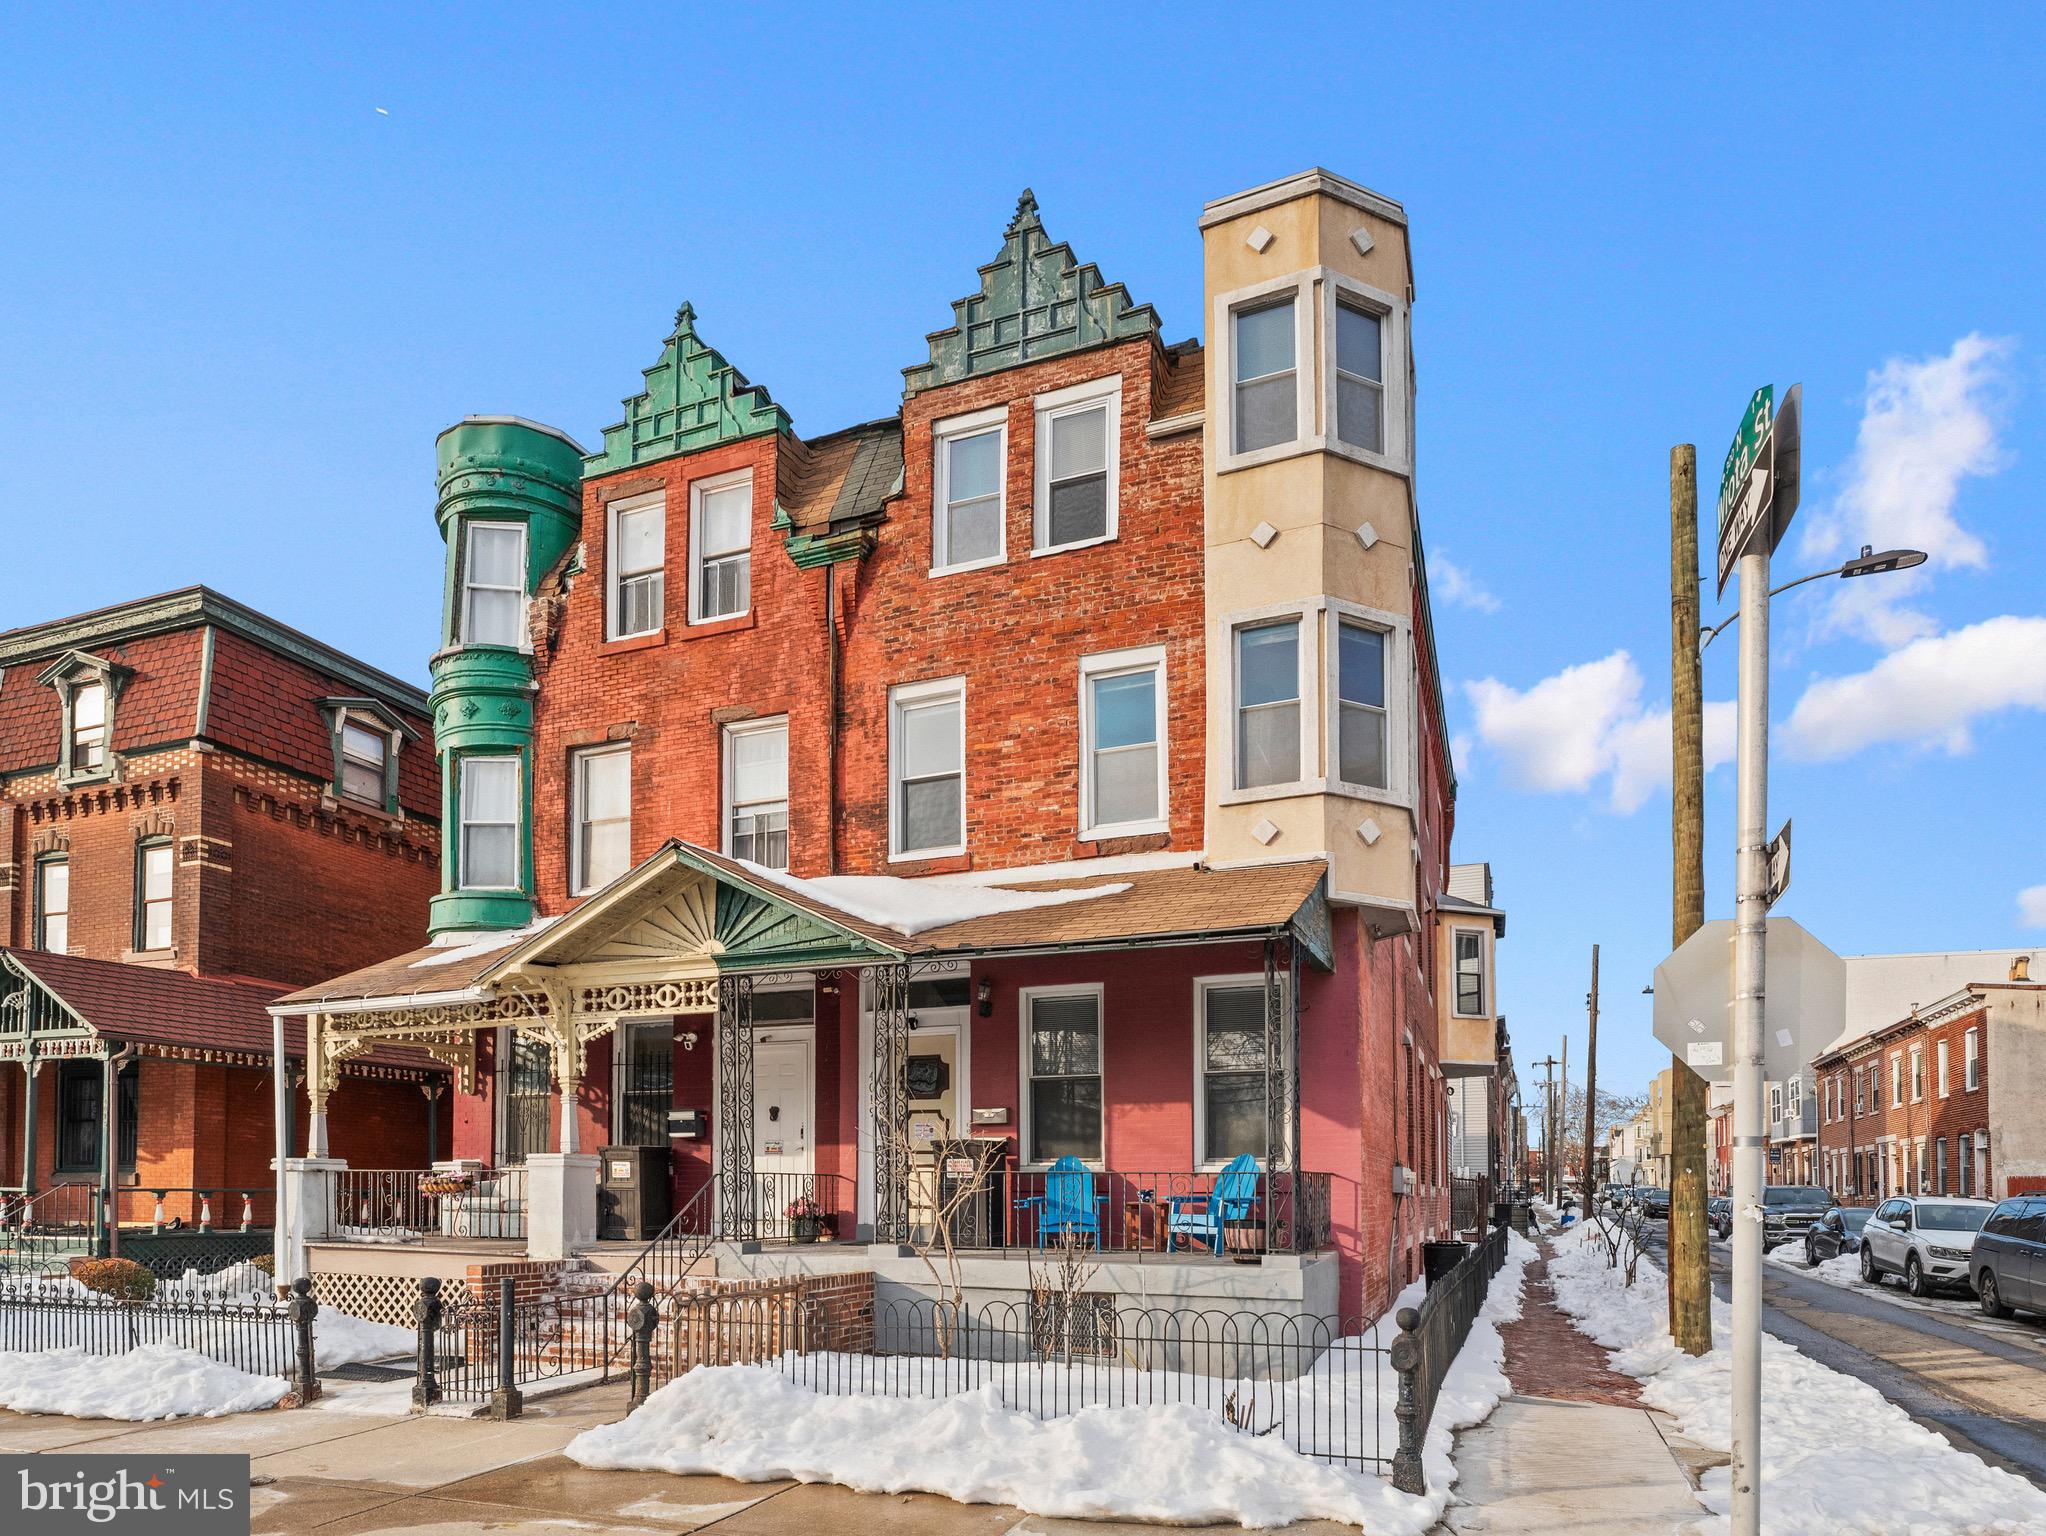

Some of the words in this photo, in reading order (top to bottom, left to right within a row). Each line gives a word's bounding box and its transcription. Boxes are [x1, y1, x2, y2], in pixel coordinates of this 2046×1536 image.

[1718, 446, 1748, 535] Wiota
[1754, 398, 1771, 450] St
[1719, 530, 1733, 573] ONE
[1734, 493, 1751, 543] WAY
